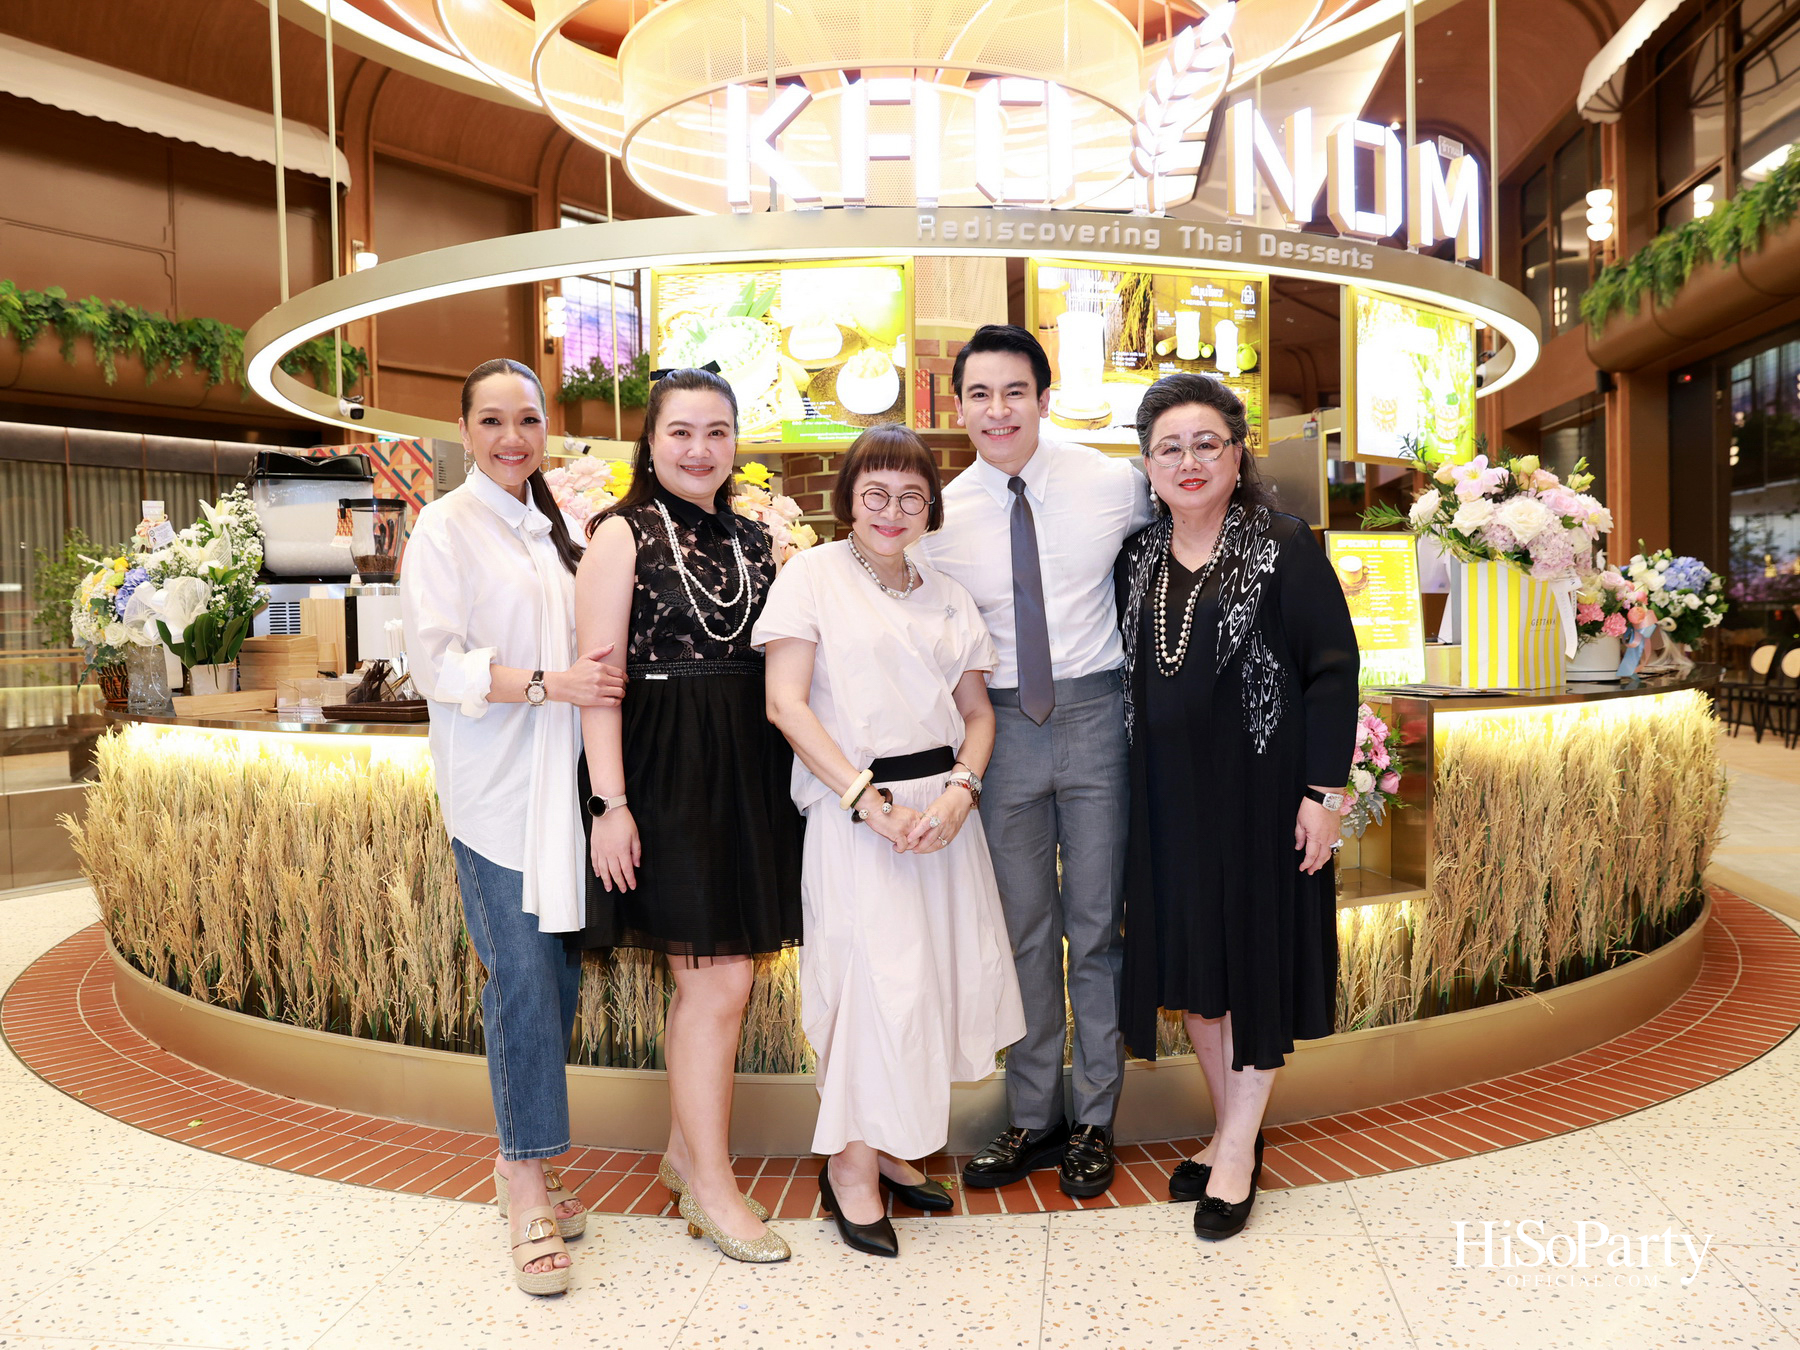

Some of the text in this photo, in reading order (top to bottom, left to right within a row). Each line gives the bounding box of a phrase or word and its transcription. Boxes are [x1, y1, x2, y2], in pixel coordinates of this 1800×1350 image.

[1226, 98, 1480, 261] NOM
[917, 214, 1374, 271] Rediscovering Thai Desserts
